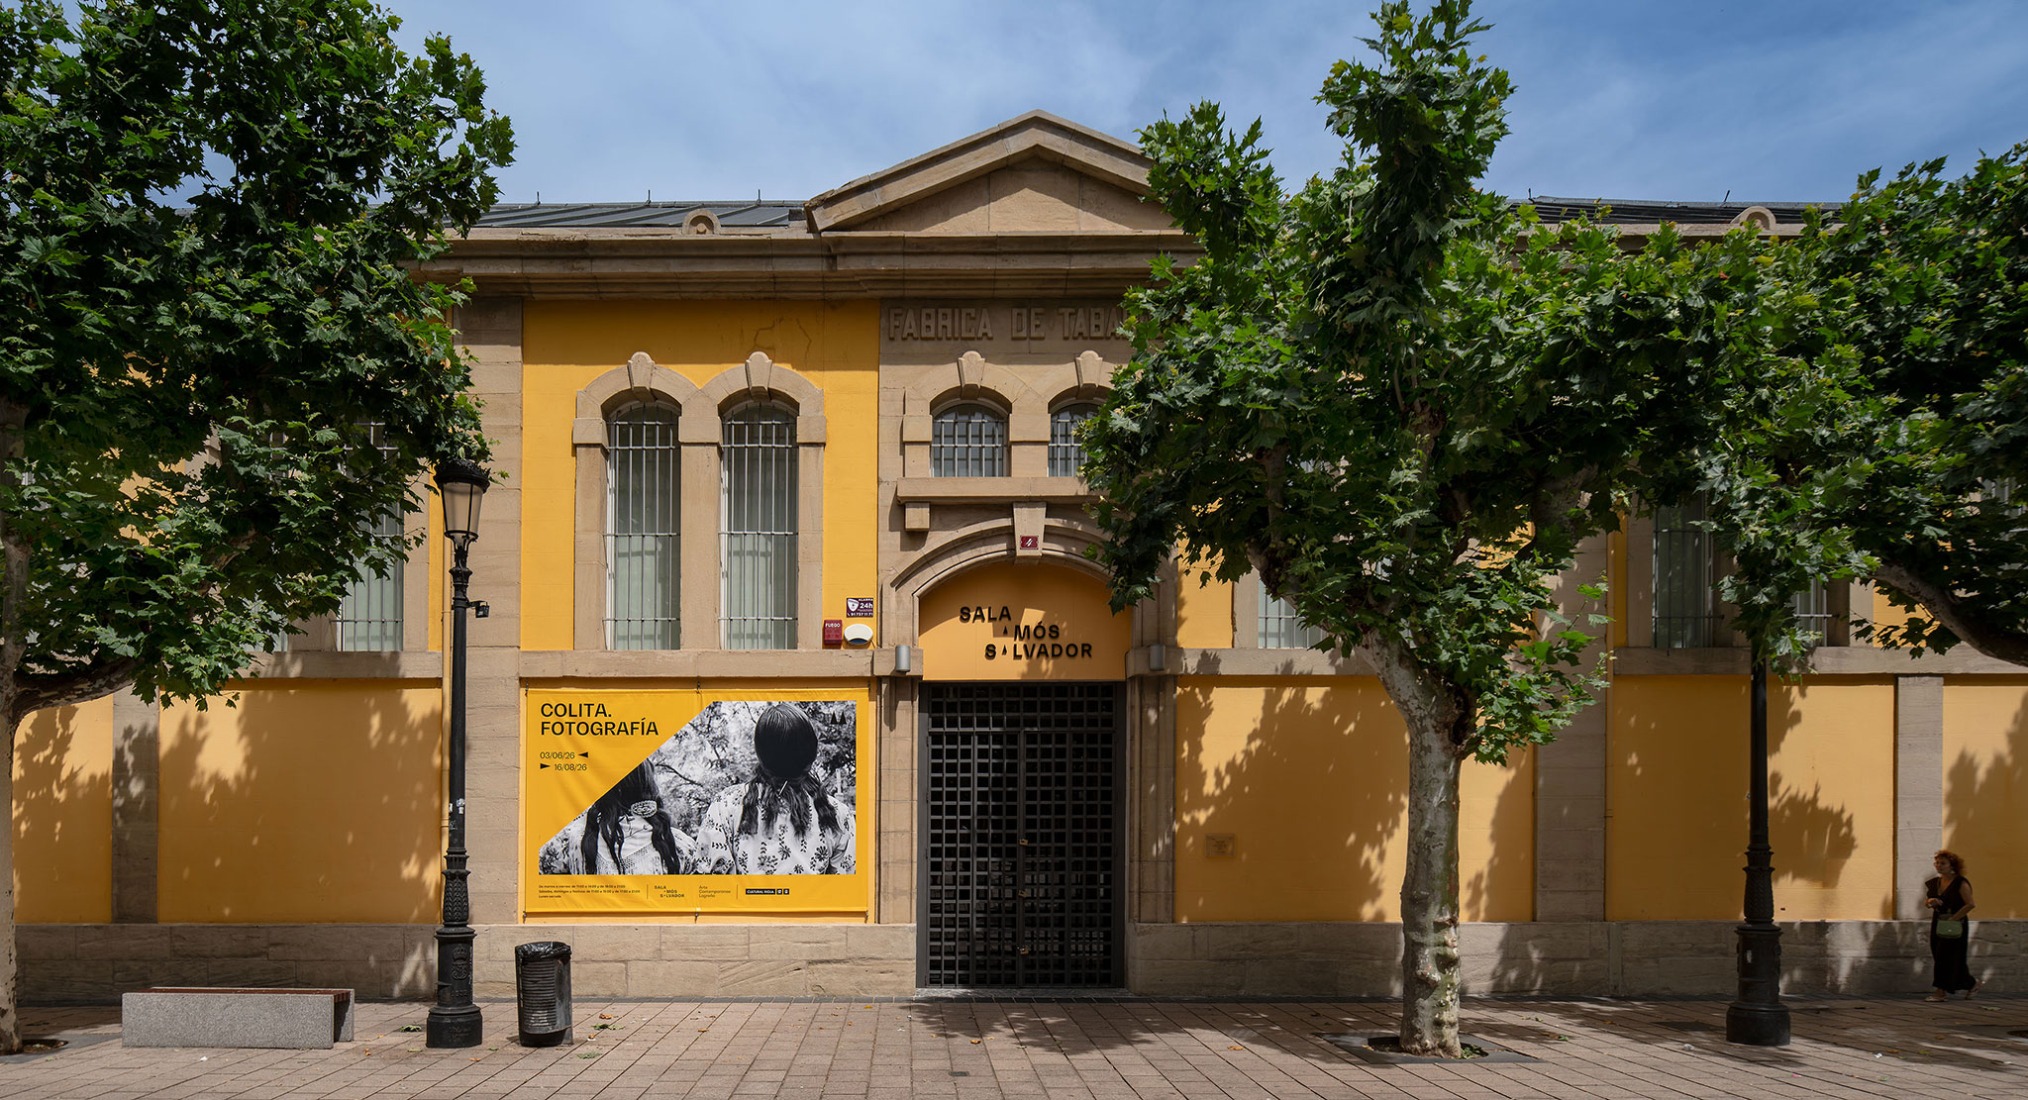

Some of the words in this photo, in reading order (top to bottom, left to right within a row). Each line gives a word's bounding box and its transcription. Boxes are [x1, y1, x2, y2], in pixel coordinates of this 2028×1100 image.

[889, 308, 994, 340] FABRICA
[1011, 308, 1045, 340] DE
[959, 606, 1012, 623] SALA
[540, 703, 612, 717] COLITA.
[541, 717, 659, 736] FOTOGRAFÍA
[540, 752, 575, 760] 03/06/26
[554, 763, 587, 771] 16/08/26
